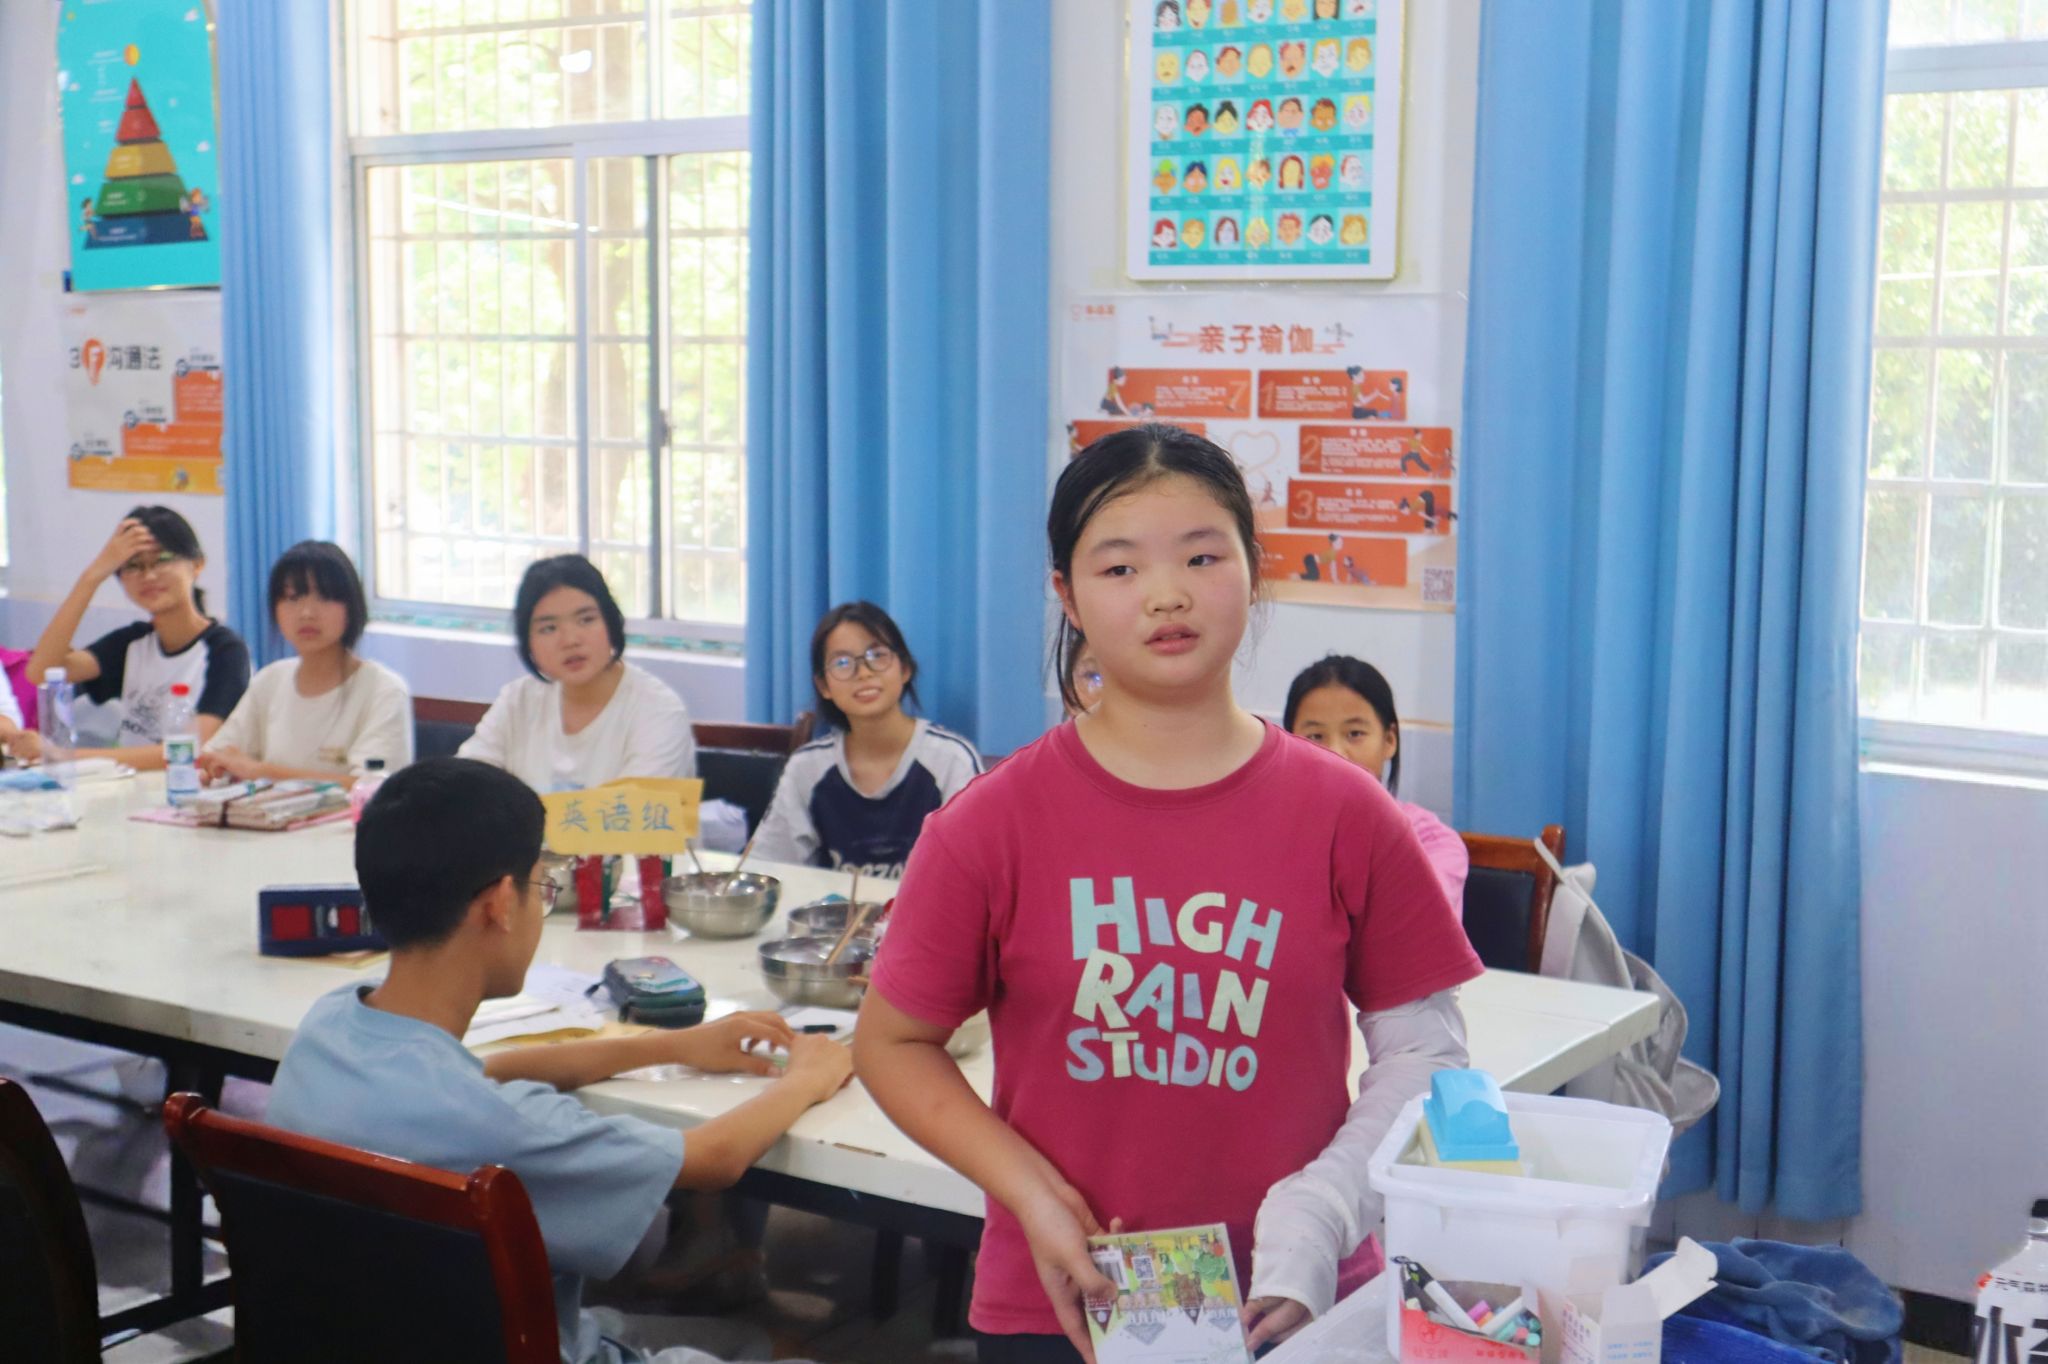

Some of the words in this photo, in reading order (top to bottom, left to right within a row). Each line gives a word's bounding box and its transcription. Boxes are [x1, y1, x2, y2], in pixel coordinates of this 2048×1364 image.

[1198, 324, 1314, 354] 亲子瑜伽
[1227, 380, 1249, 412] 7
[1302, 434, 1320, 465] 2
[1292, 489, 1314, 519] 3
[559, 794, 674, 833] 英语组
[1070, 876, 1283, 971] HIGH
[1072, 948, 1269, 1038] RAIN
